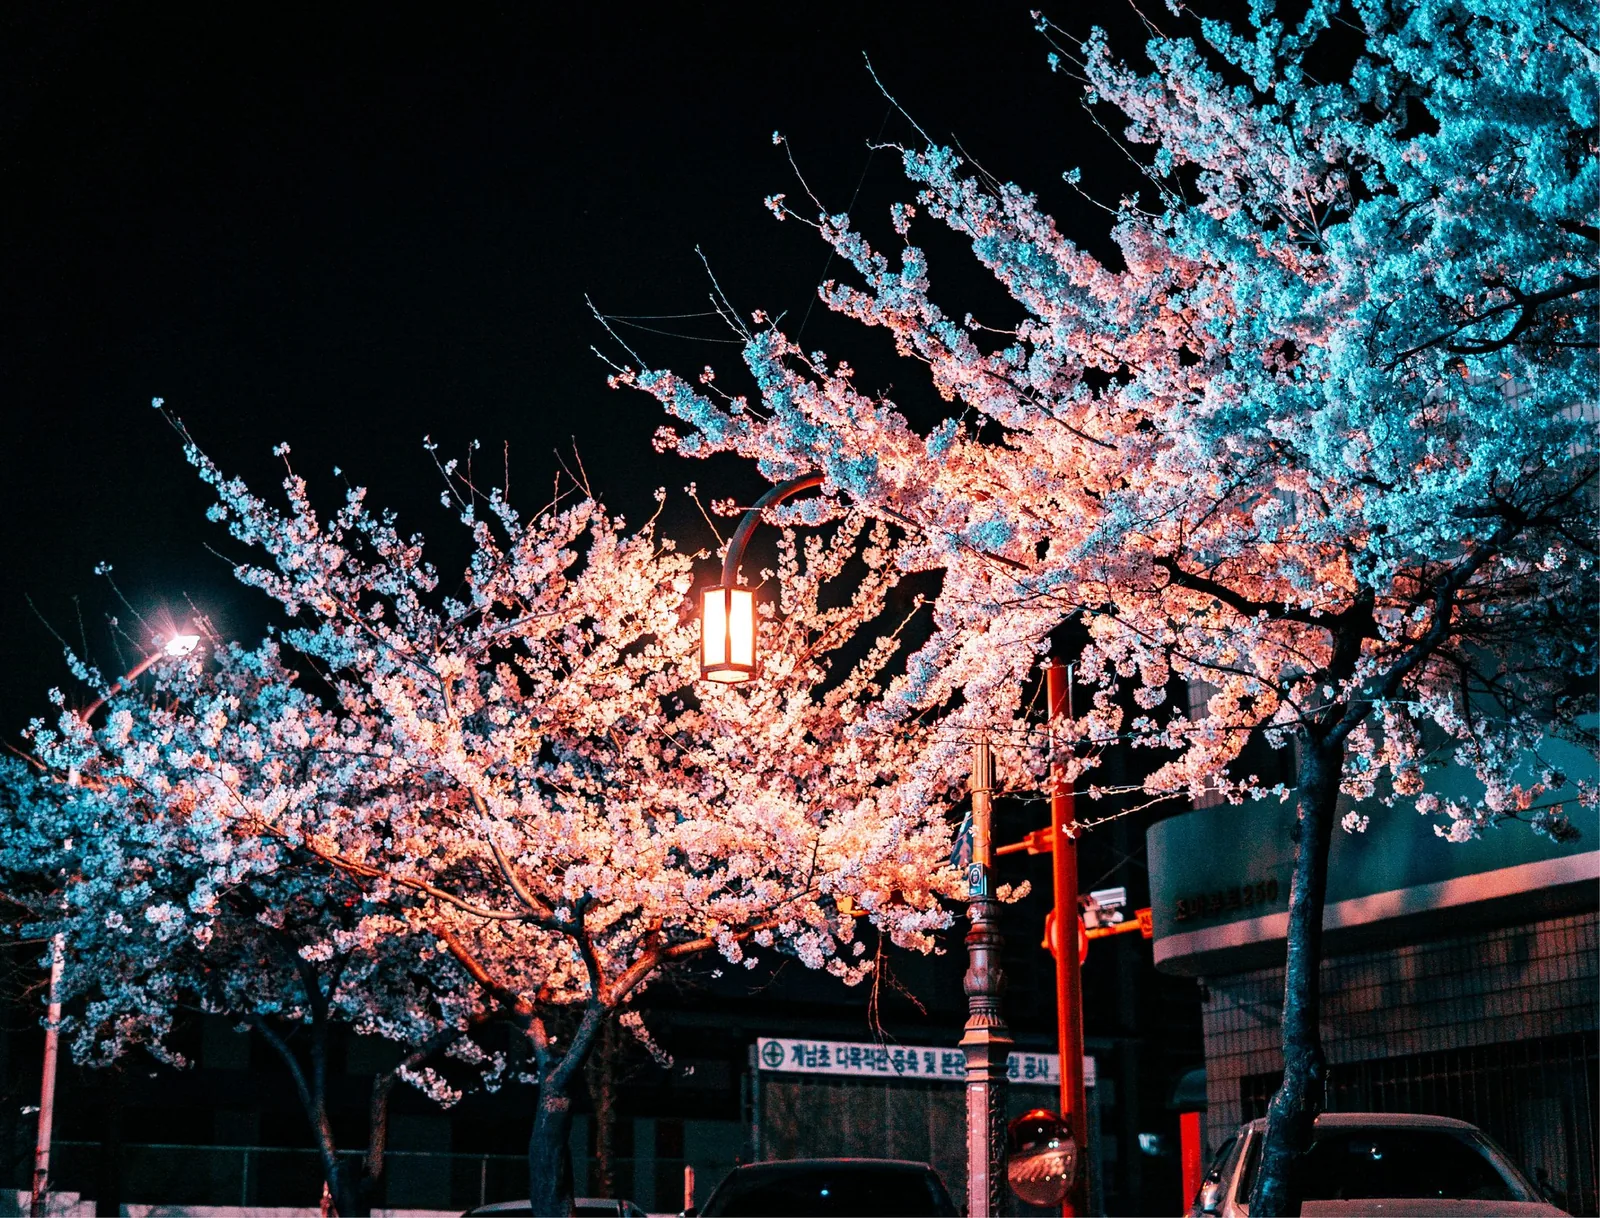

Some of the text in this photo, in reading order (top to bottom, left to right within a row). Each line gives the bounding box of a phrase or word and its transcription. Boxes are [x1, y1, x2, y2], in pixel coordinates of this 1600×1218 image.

[836, 1046, 889, 1072] 다목적관
[893, 1049, 918, 1074] 증축
[923, 1051, 936, 1074] 및
[942, 1052, 966, 1076] 본관
[1024, 1056, 1049, 1080] 공사
